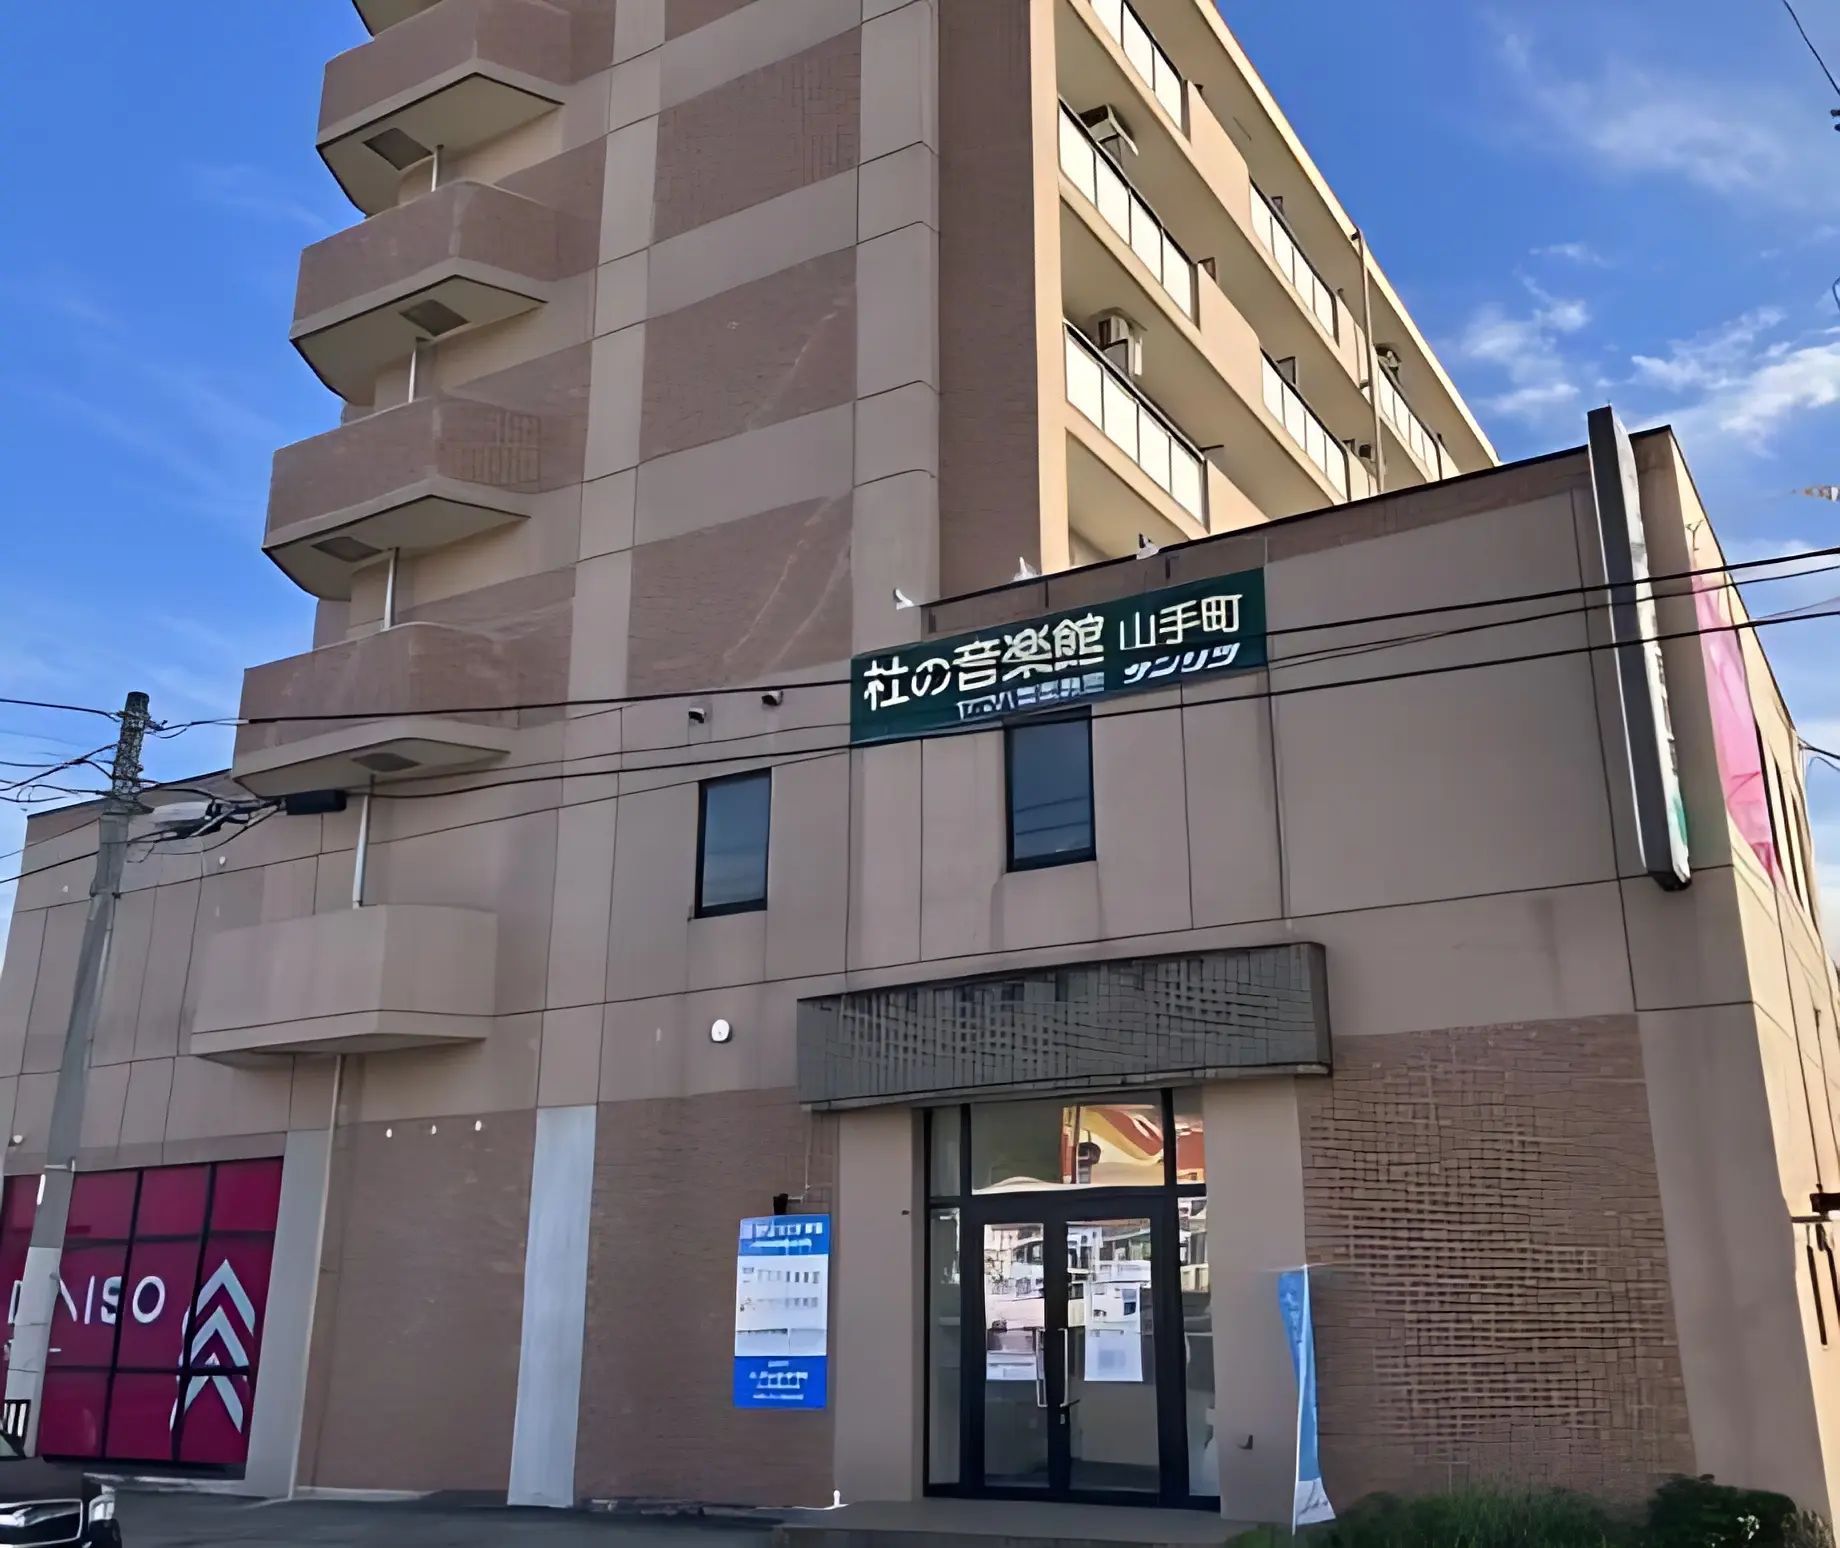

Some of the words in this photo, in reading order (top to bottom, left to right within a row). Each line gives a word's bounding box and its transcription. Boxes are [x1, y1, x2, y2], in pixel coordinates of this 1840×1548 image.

[1120, 594, 1243, 651] 山手町
[8, 1275, 165, 1325] ISO
